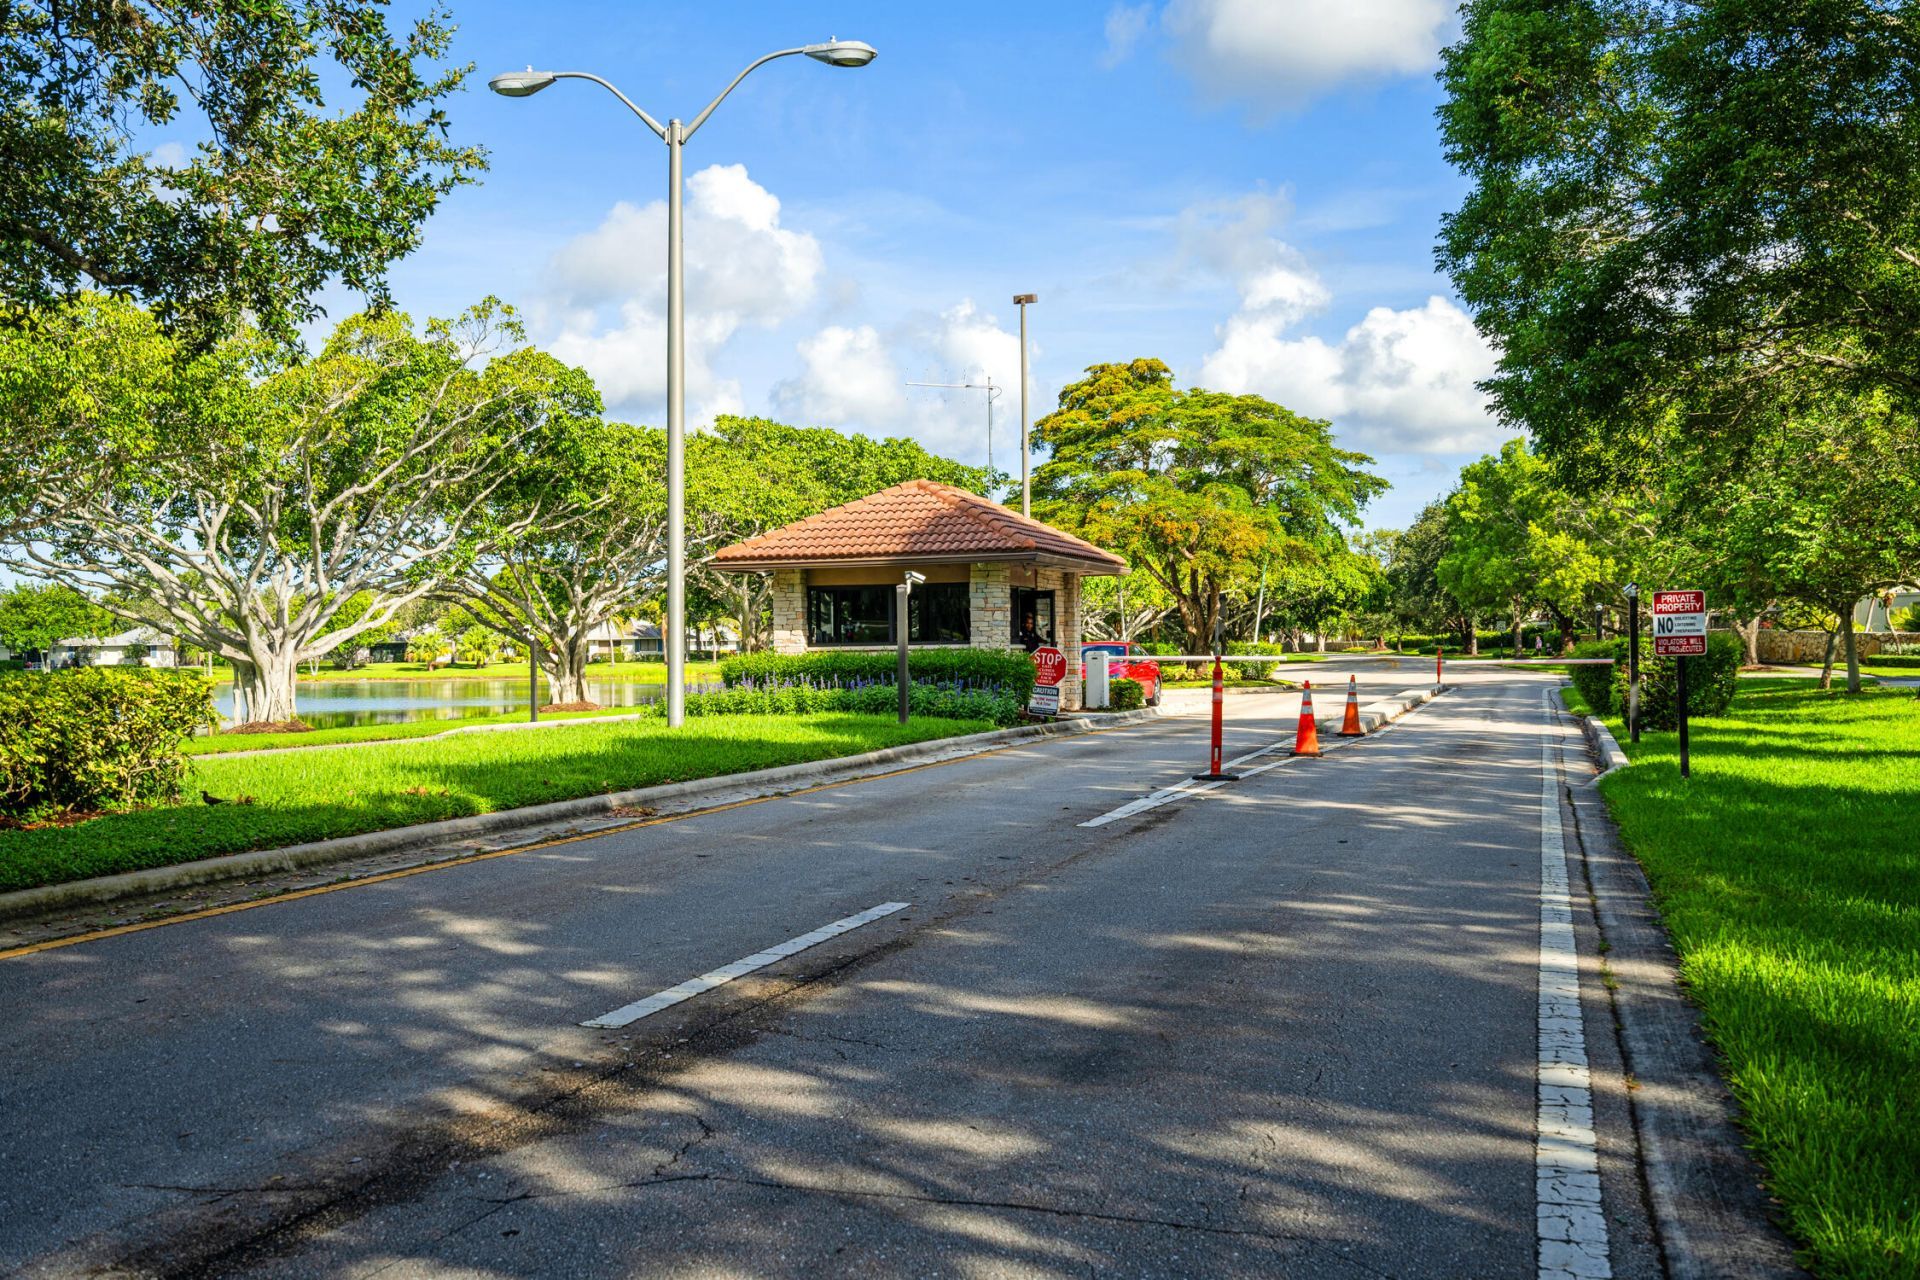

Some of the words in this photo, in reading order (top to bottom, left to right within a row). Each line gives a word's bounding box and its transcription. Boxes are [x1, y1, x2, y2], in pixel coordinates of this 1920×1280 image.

[1661, 594, 1696, 603] PRIVATE
[1656, 602, 1701, 612] PROPERTY
[1658, 617, 1674, 634] NO
[1034, 652, 1062, 666] STOP
[1032, 686, 1058, 695] CAUTION
